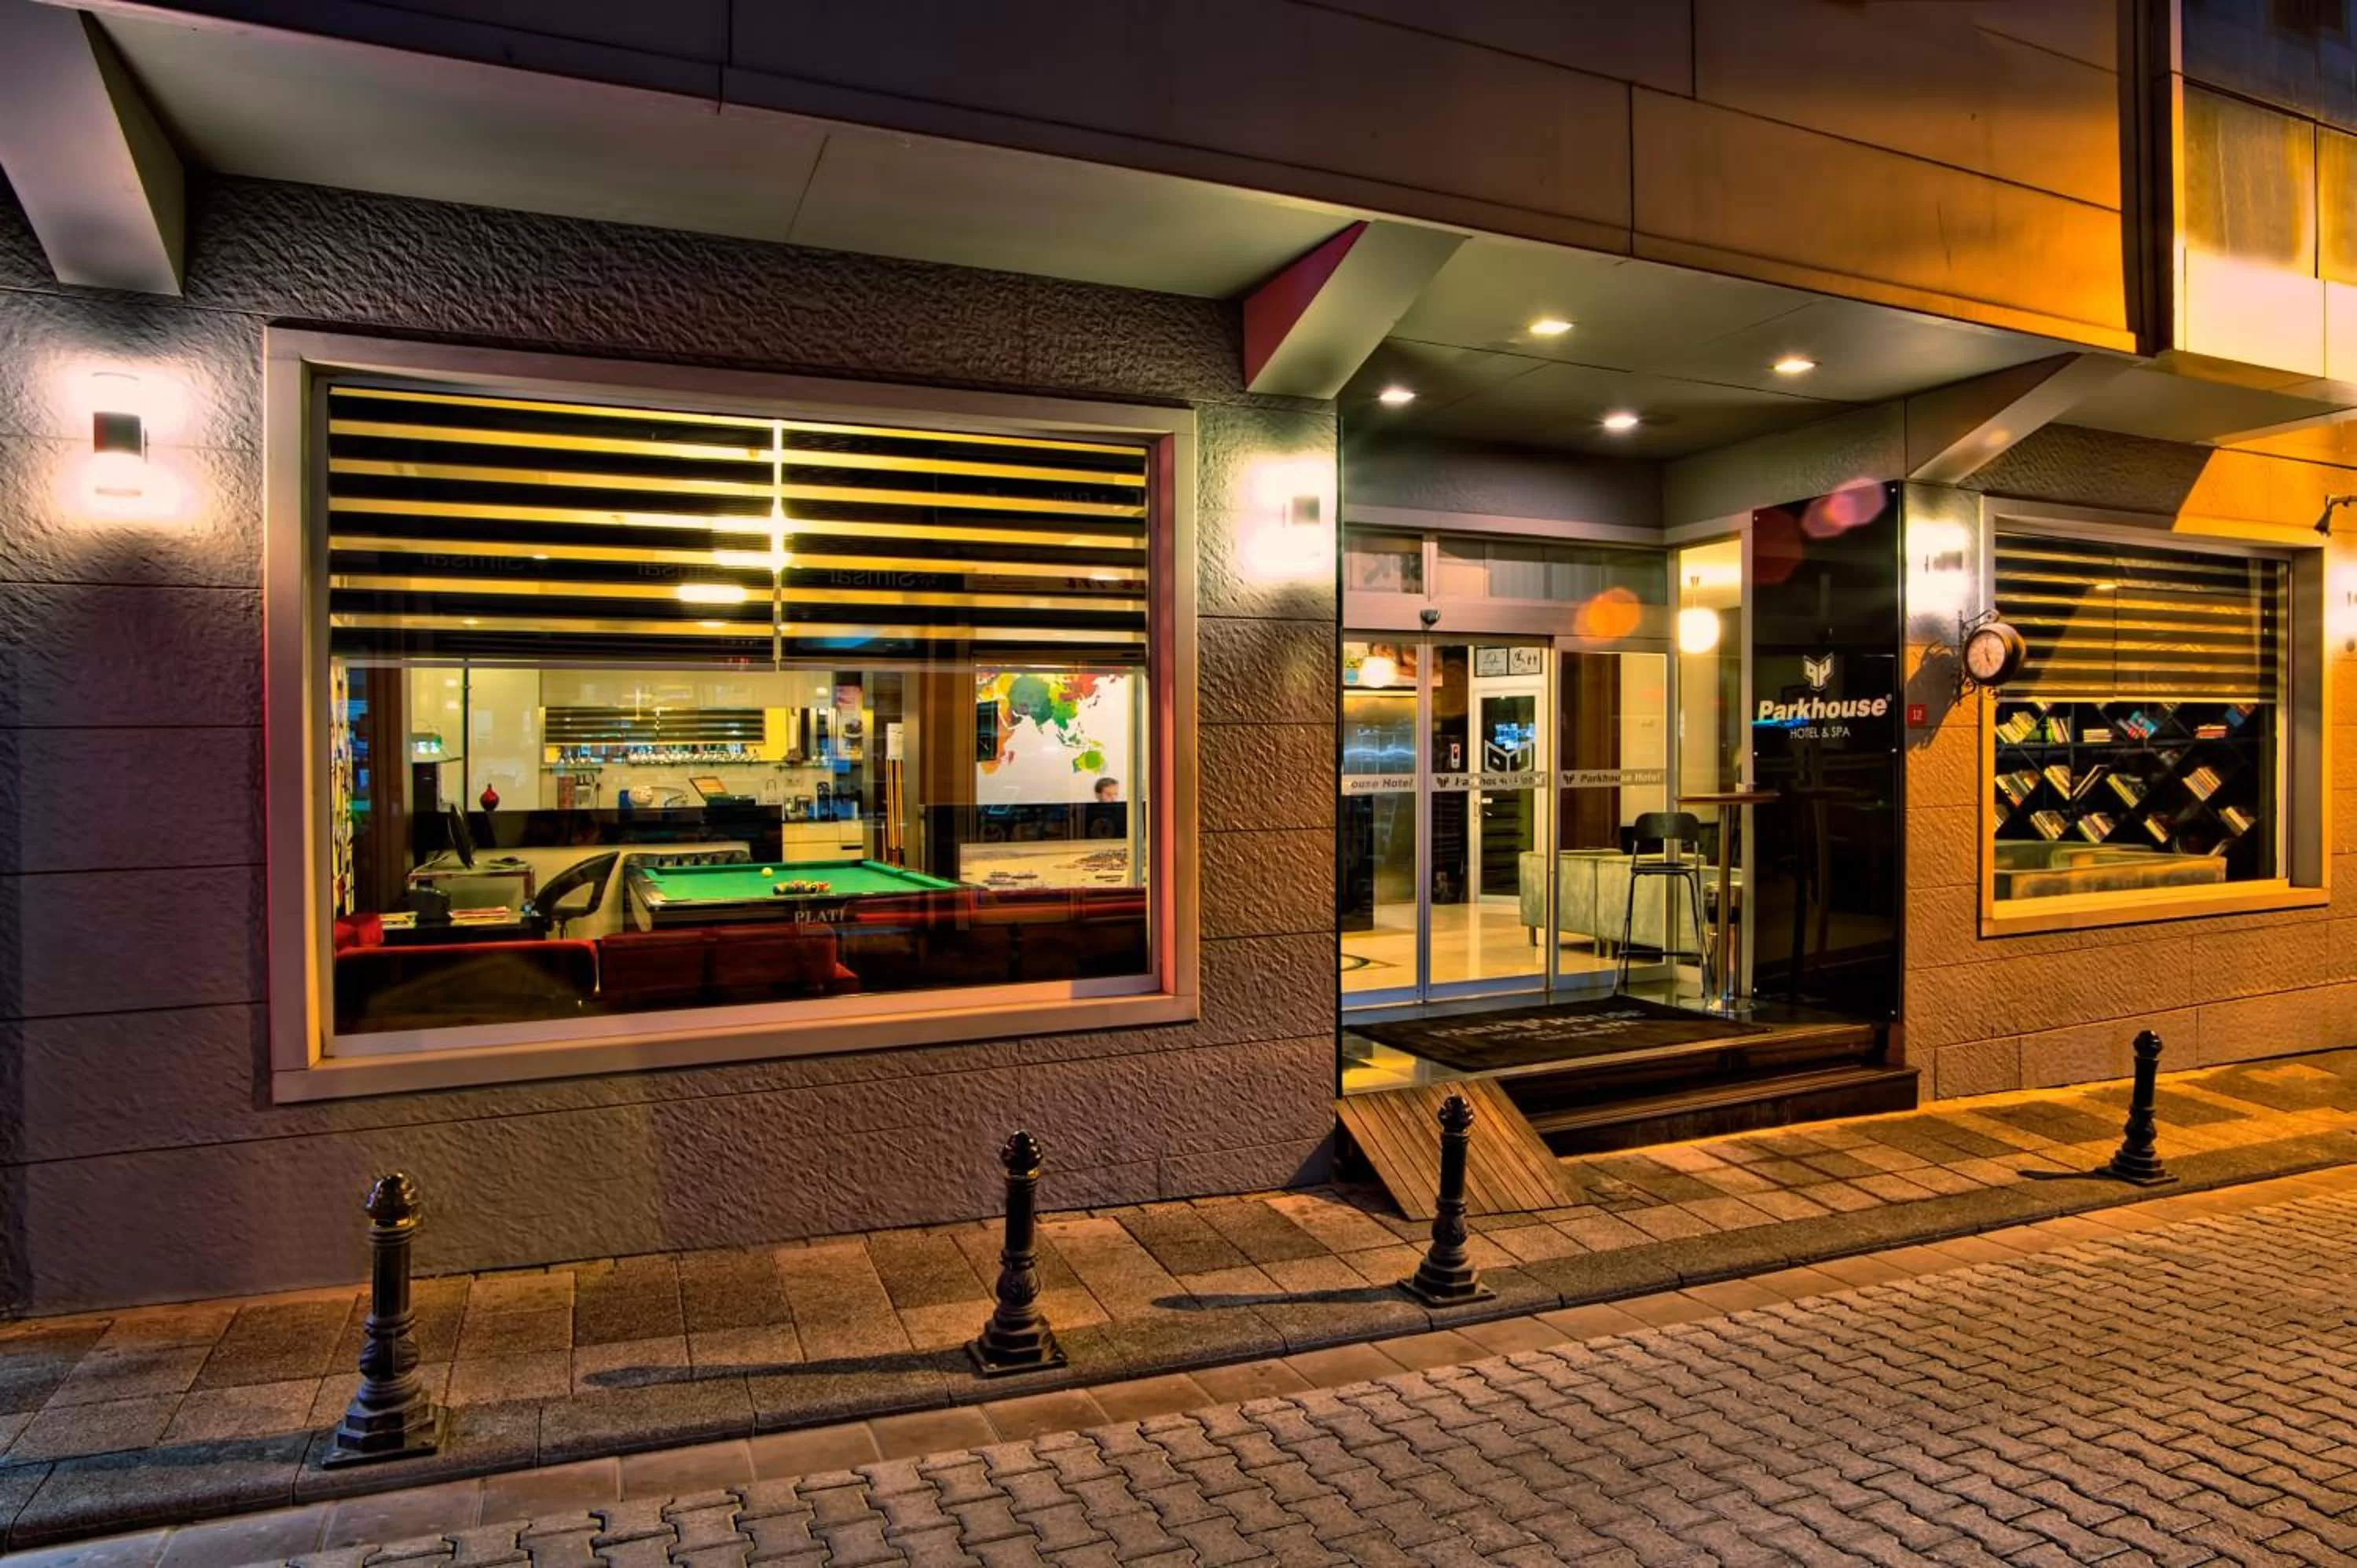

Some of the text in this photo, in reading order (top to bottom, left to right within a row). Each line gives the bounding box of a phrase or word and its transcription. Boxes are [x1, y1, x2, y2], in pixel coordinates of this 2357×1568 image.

[1758, 697, 1888, 720] Parkhouse
[1790, 727, 1820, 739] HOTEL
[1831, 725, 1851, 738] SPA
